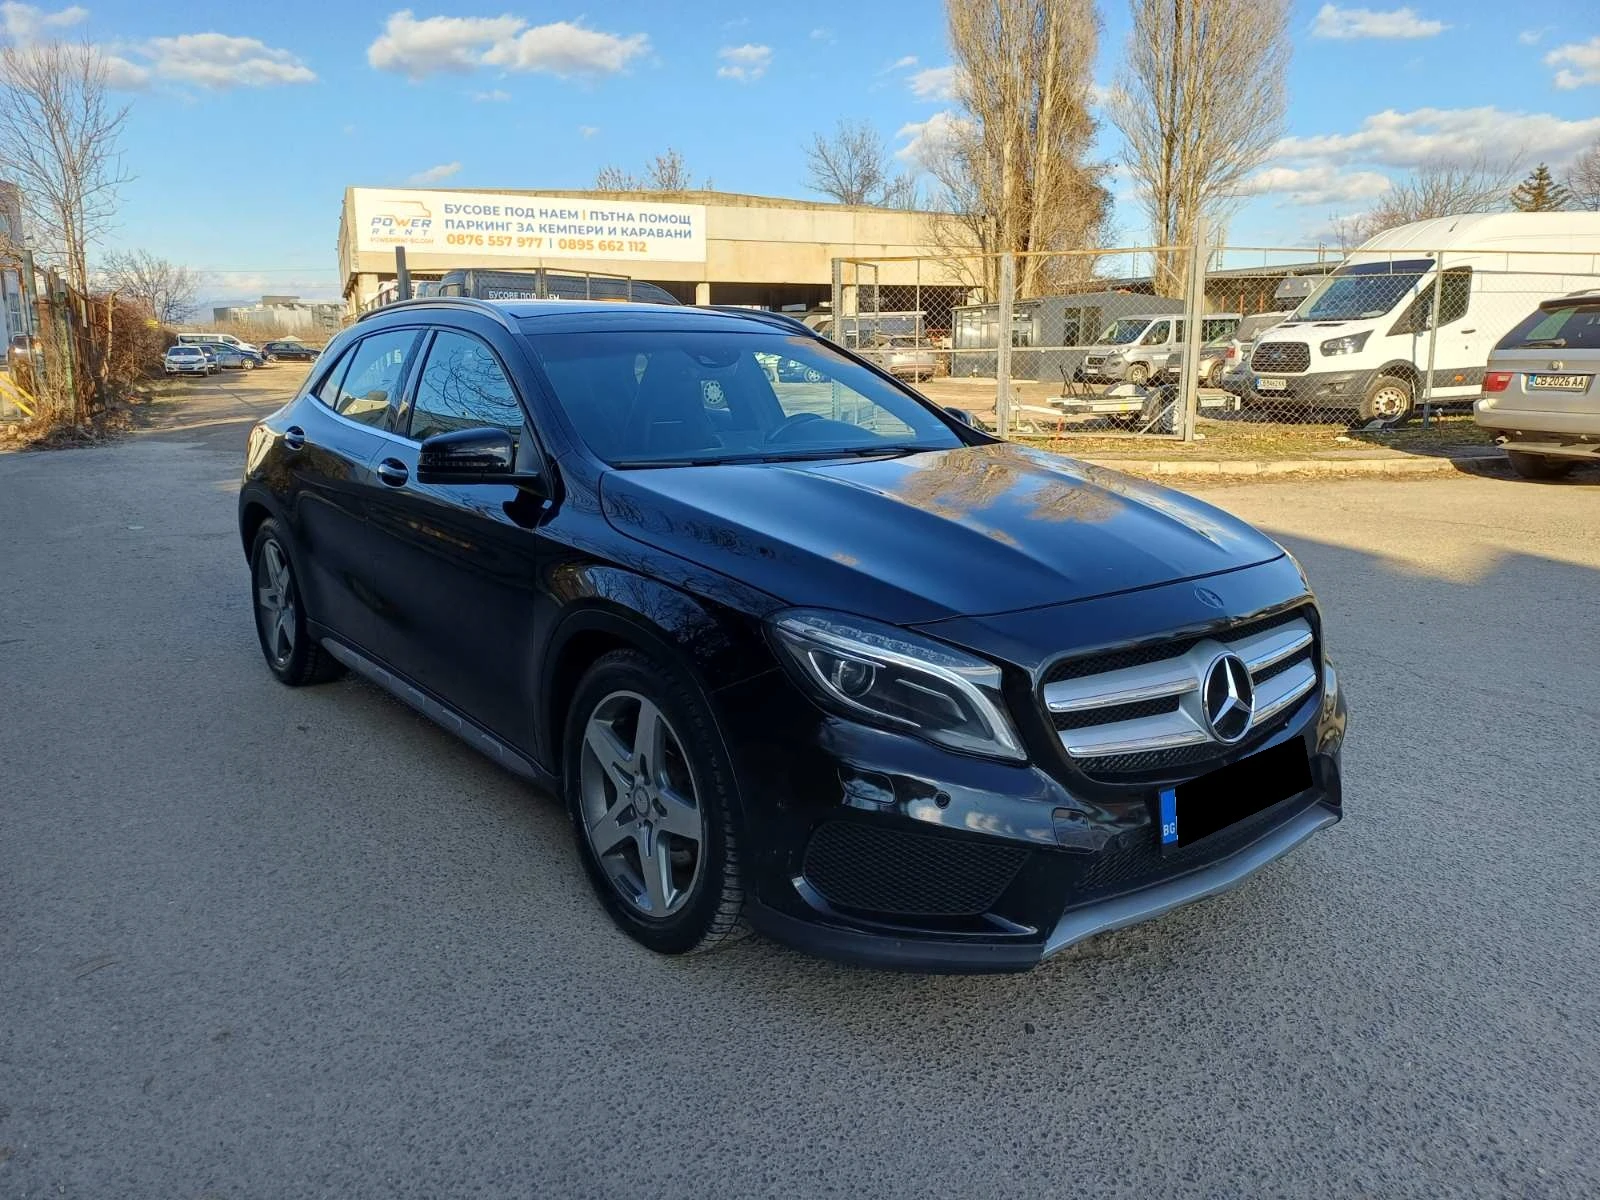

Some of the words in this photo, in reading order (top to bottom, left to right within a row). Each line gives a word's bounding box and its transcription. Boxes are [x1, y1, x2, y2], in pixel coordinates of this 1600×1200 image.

[444, 203, 501, 217] БУСОВЕ
[505, 206, 536, 219] ПОД
[539, 209, 579, 221] НАЕМ
[589, 210, 636, 223] ПЪТНА
[639, 213, 692, 227] ПОМОЩ
[370, 217, 433, 229] POWER
[444, 219, 513, 233] ПАРКИНГ
[517, 222, 535, 234] ЗА
[539, 223, 604, 236] КЕМПЕРИ
[607, 226, 618, 237] И
[621, 227, 693, 240] КАРАВАНИ
[371, 228, 430, 236] RENT
[446, 233, 485, 246] 0876
[487, 235, 513, 248] 557
[516, 237, 543, 249] 977
[558, 238, 595, 251] 0895
[598, 240, 625, 252] 662
[628, 241, 648, 253] 112
[1535, 375, 1547, 386] CB
[1548, 376, 1570, 387] 2026
[1572, 377, 1584, 386] AA
[1163, 822, 1176, 837] BG
